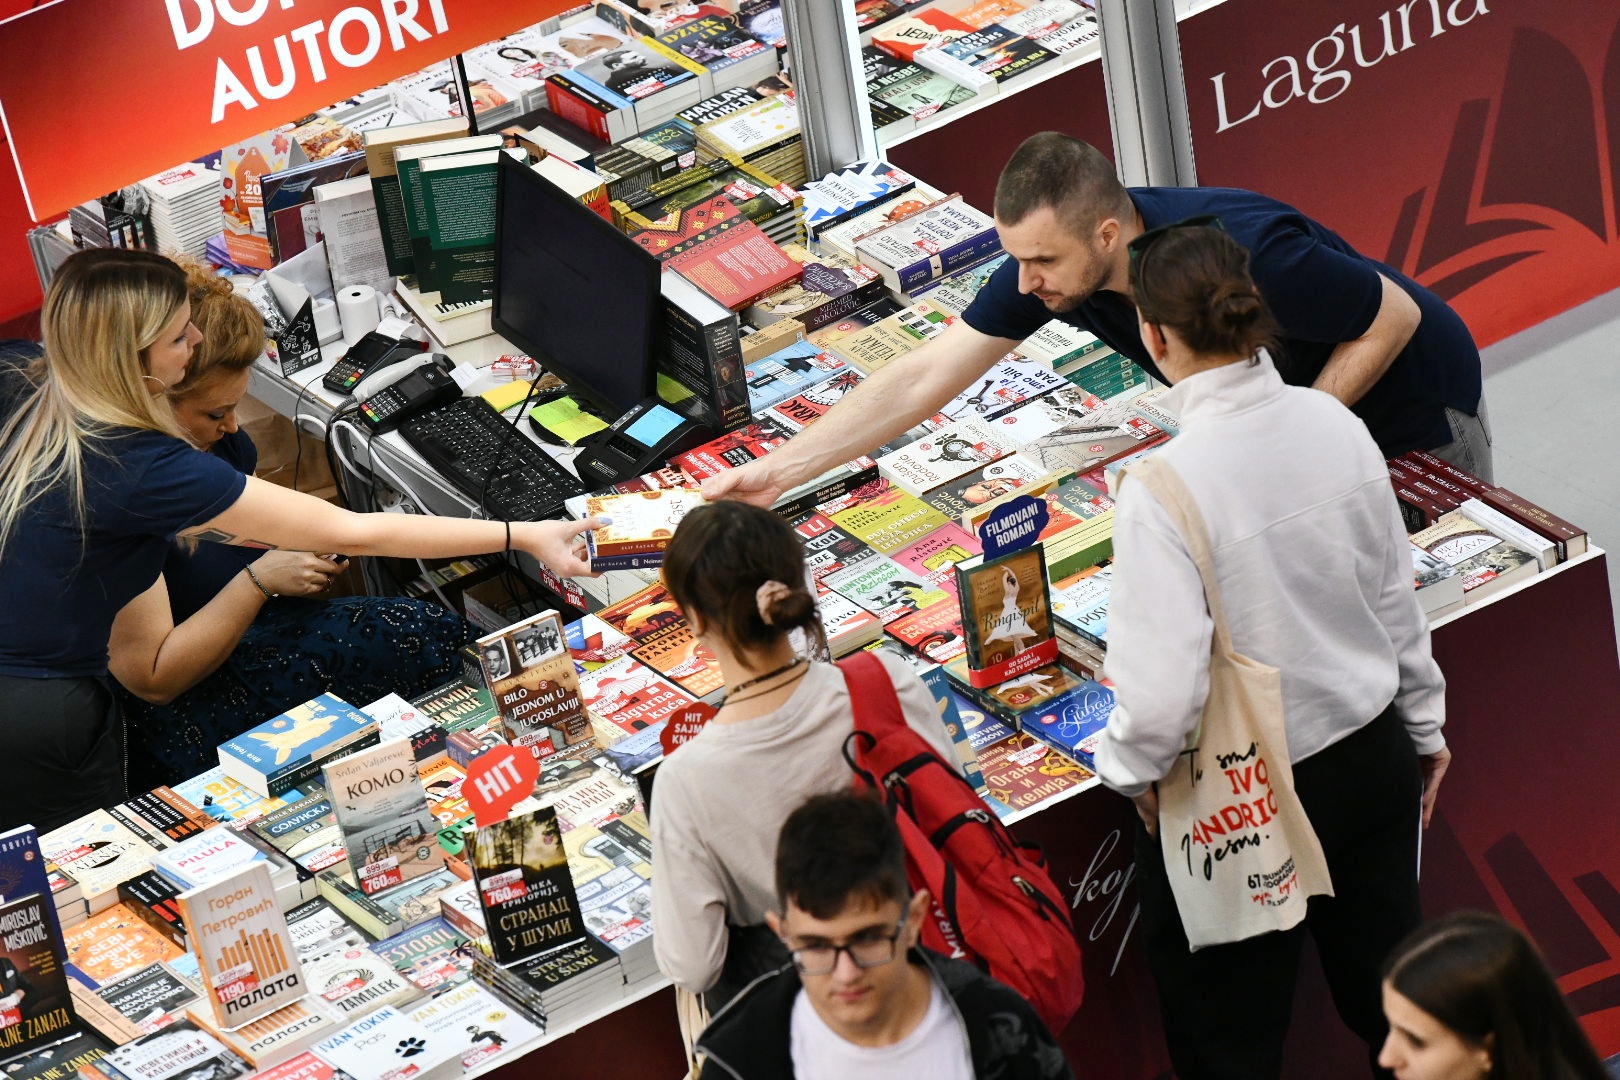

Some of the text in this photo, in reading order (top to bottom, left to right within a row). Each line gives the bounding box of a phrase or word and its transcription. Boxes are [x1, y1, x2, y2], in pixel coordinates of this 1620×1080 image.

[952, 30, 1004, 57] PARSONS
[956, 31, 984, 46] TONI
[1042, 20, 1085, 43] DEVOJKA
[210, 0, 449, 124] AUTORI
[1210, 0, 1491, 133] Laguna
[881, 65, 921, 88] NESBE
[680, 87, 749, 122] HARLAN
[944, 206, 985, 231] МАСКАМА
[819, 294, 854, 315] MEHMED
[1022, 377, 1047, 390] smo
[1034, 369, 1059, 385] PAR
[893, 463, 925, 485] Dušan
[809, 519, 826, 534] LI
[985, 502, 1039, 538] FILMOVANI
[996, 519, 1035, 548] ROMANI
[810, 532, 840, 550] kod
[909, 536, 953, 562] Ristović
[914, 537, 936, 553] Ana
[855, 567, 900, 596] RAZLOGOM
[982, 601, 1041, 633] Ringišpil
[637, 628, 692, 657] BRONJA
[991, 653, 1003, 665] 10
[1004, 656, 1042, 678] KAO TV SERIJA
[1008, 658, 1017, 669] OD
[1016, 654, 1032, 667] SADA
[417, 684, 479, 715] LHEMIJA
[503, 688, 528, 705] BILO
[512, 687, 566, 719] JEDNOM U
[612, 688, 676, 724] Sigurna
[647, 697, 688, 720] kuća
[430, 697, 486, 725] BOMBE
[519, 697, 579, 731] JUGOSLAVIJI
[684, 712, 703, 723] HIT
[1056, 690, 1112, 739] Ljubav
[674, 721, 704, 734] SAJM
[346, 768, 405, 800] KOMO
[473, 754, 523, 804] HIT
[989, 763, 1036, 788] Огањ
[1021, 777, 1036, 788] и
[1014, 776, 1069, 808] келија
[271, 802, 331, 834] СОЛУНСКА
[303, 821, 322, 834] 28
[168, 833, 227, 862] Gorka
[177, 840, 238, 868] PILULA
[364, 874, 387, 893] 760
[488, 887, 512, 904] 760
[207, 887, 254, 913] Горан
[500, 895, 571, 932] СТРАНАЦ
[0, 905, 41, 934] MIROSLAV
[201, 897, 275, 938] Петровић
[4, 923, 48, 952] MIŠKOVIĆ
[87, 932, 126, 956] SEBI
[378, 928, 457, 966] ESTORIL
[506, 916, 574, 953] У ШУМИ
[110, 948, 145, 970] SVE
[528, 944, 594, 980] STRANAC
[544, 953, 600, 985] U ŠUMI
[118, 965, 162, 988] Valjarević
[110, 976, 170, 1008] NARATOR JE
[119, 984, 172, 1012] KONAČNO
[216, 981, 245, 1003] 1190
[226, 972, 299, 1015] палата
[337, 978, 401, 1014] ZAMALEK
[440, 985, 480, 1009] TOKIN
[0, 1007, 71, 1049] AJNE ZANATA
[249, 1012, 322, 1053] палата
[317, 1029, 353, 1054] IVAN
[352, 1008, 395, 1034] TOKIN
[353, 1030, 388, 1052] Pas
[62, 1047, 109, 1073] ZANATA
